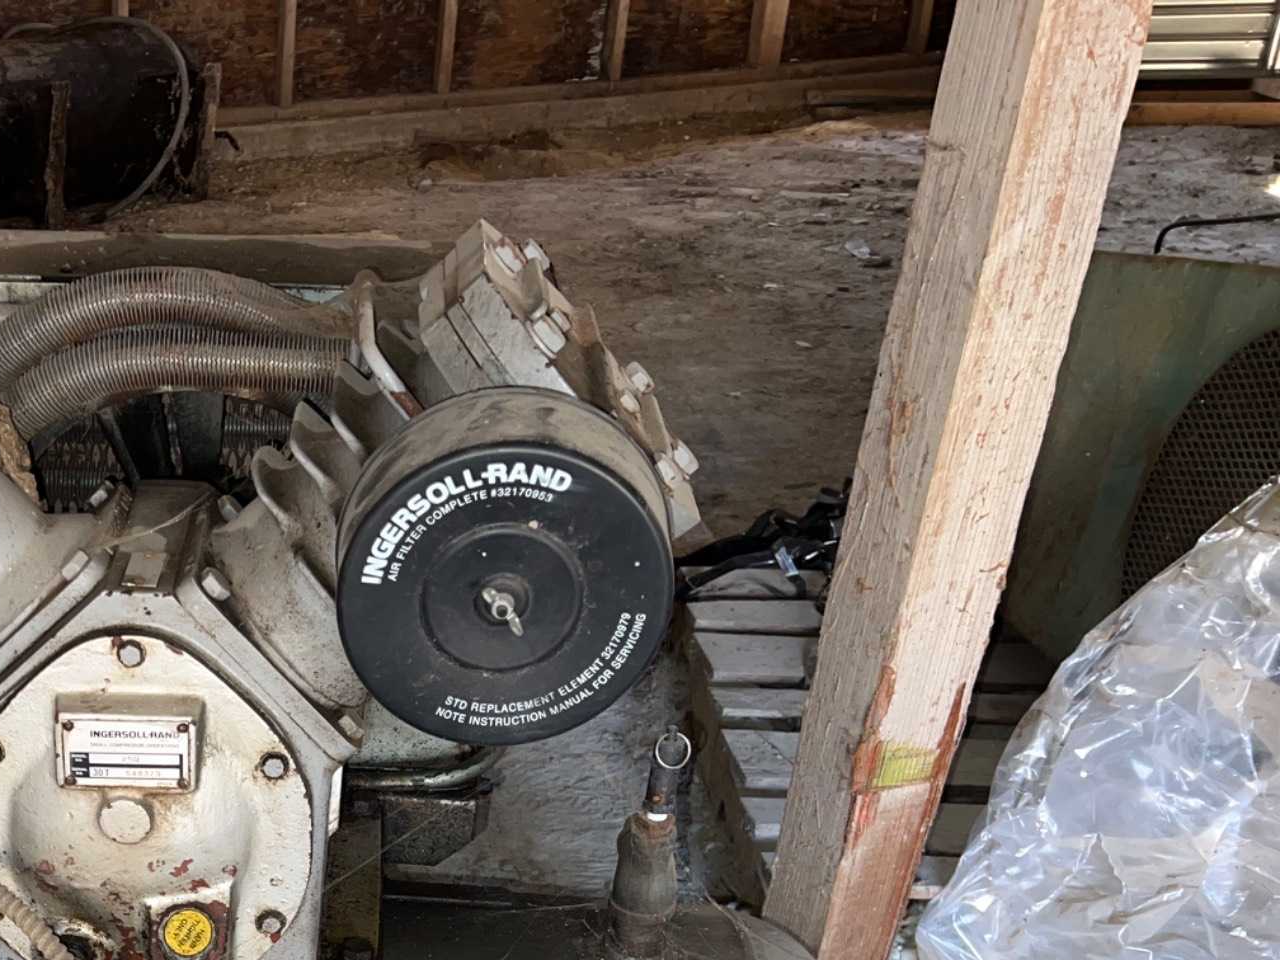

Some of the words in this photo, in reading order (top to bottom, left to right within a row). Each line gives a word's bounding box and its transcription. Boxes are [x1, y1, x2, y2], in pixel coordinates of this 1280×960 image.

[361, 462, 573, 585] INGERSOLL-RAND
[426, 488, 488, 526] COMPLETE
[388, 565, 401, 582] AIR
[393, 524, 427, 566] FILTER
[435, 706, 466, 725] NOTE
[468, 710, 548, 728] INSTRUCTION
[549, 688, 595, 716] MANUAL
[592, 668, 615, 690] FOR
[612, 612, 648, 670] SERVICING
[444, 695, 468, 711] STD
[471, 692, 556, 714] REPLACEMENT
[558, 657, 606, 697] ELEMENT
[600, 612, 632, 660] 32170979
